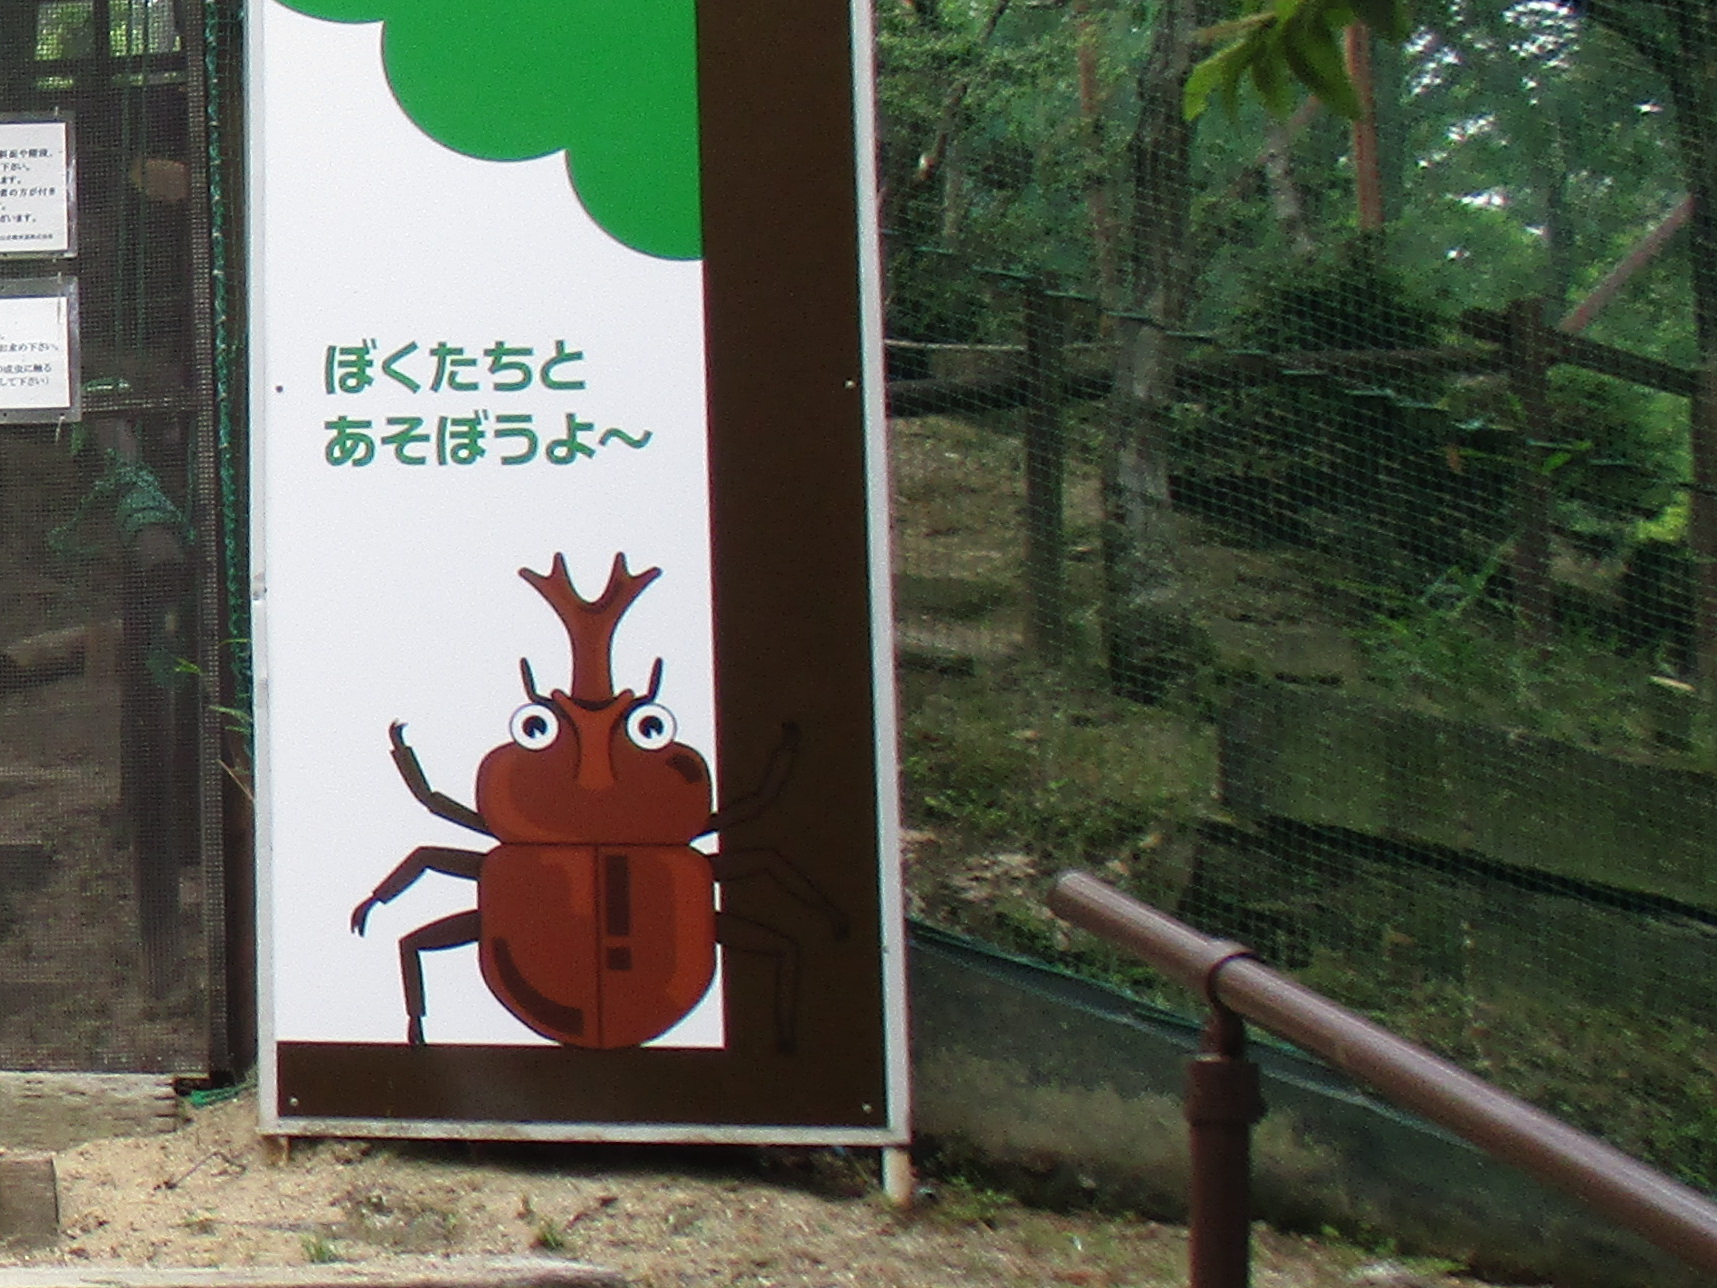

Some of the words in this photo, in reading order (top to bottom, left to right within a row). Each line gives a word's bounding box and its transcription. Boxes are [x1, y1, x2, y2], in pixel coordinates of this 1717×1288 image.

[324, 338, 586, 395] ぼくたちと
